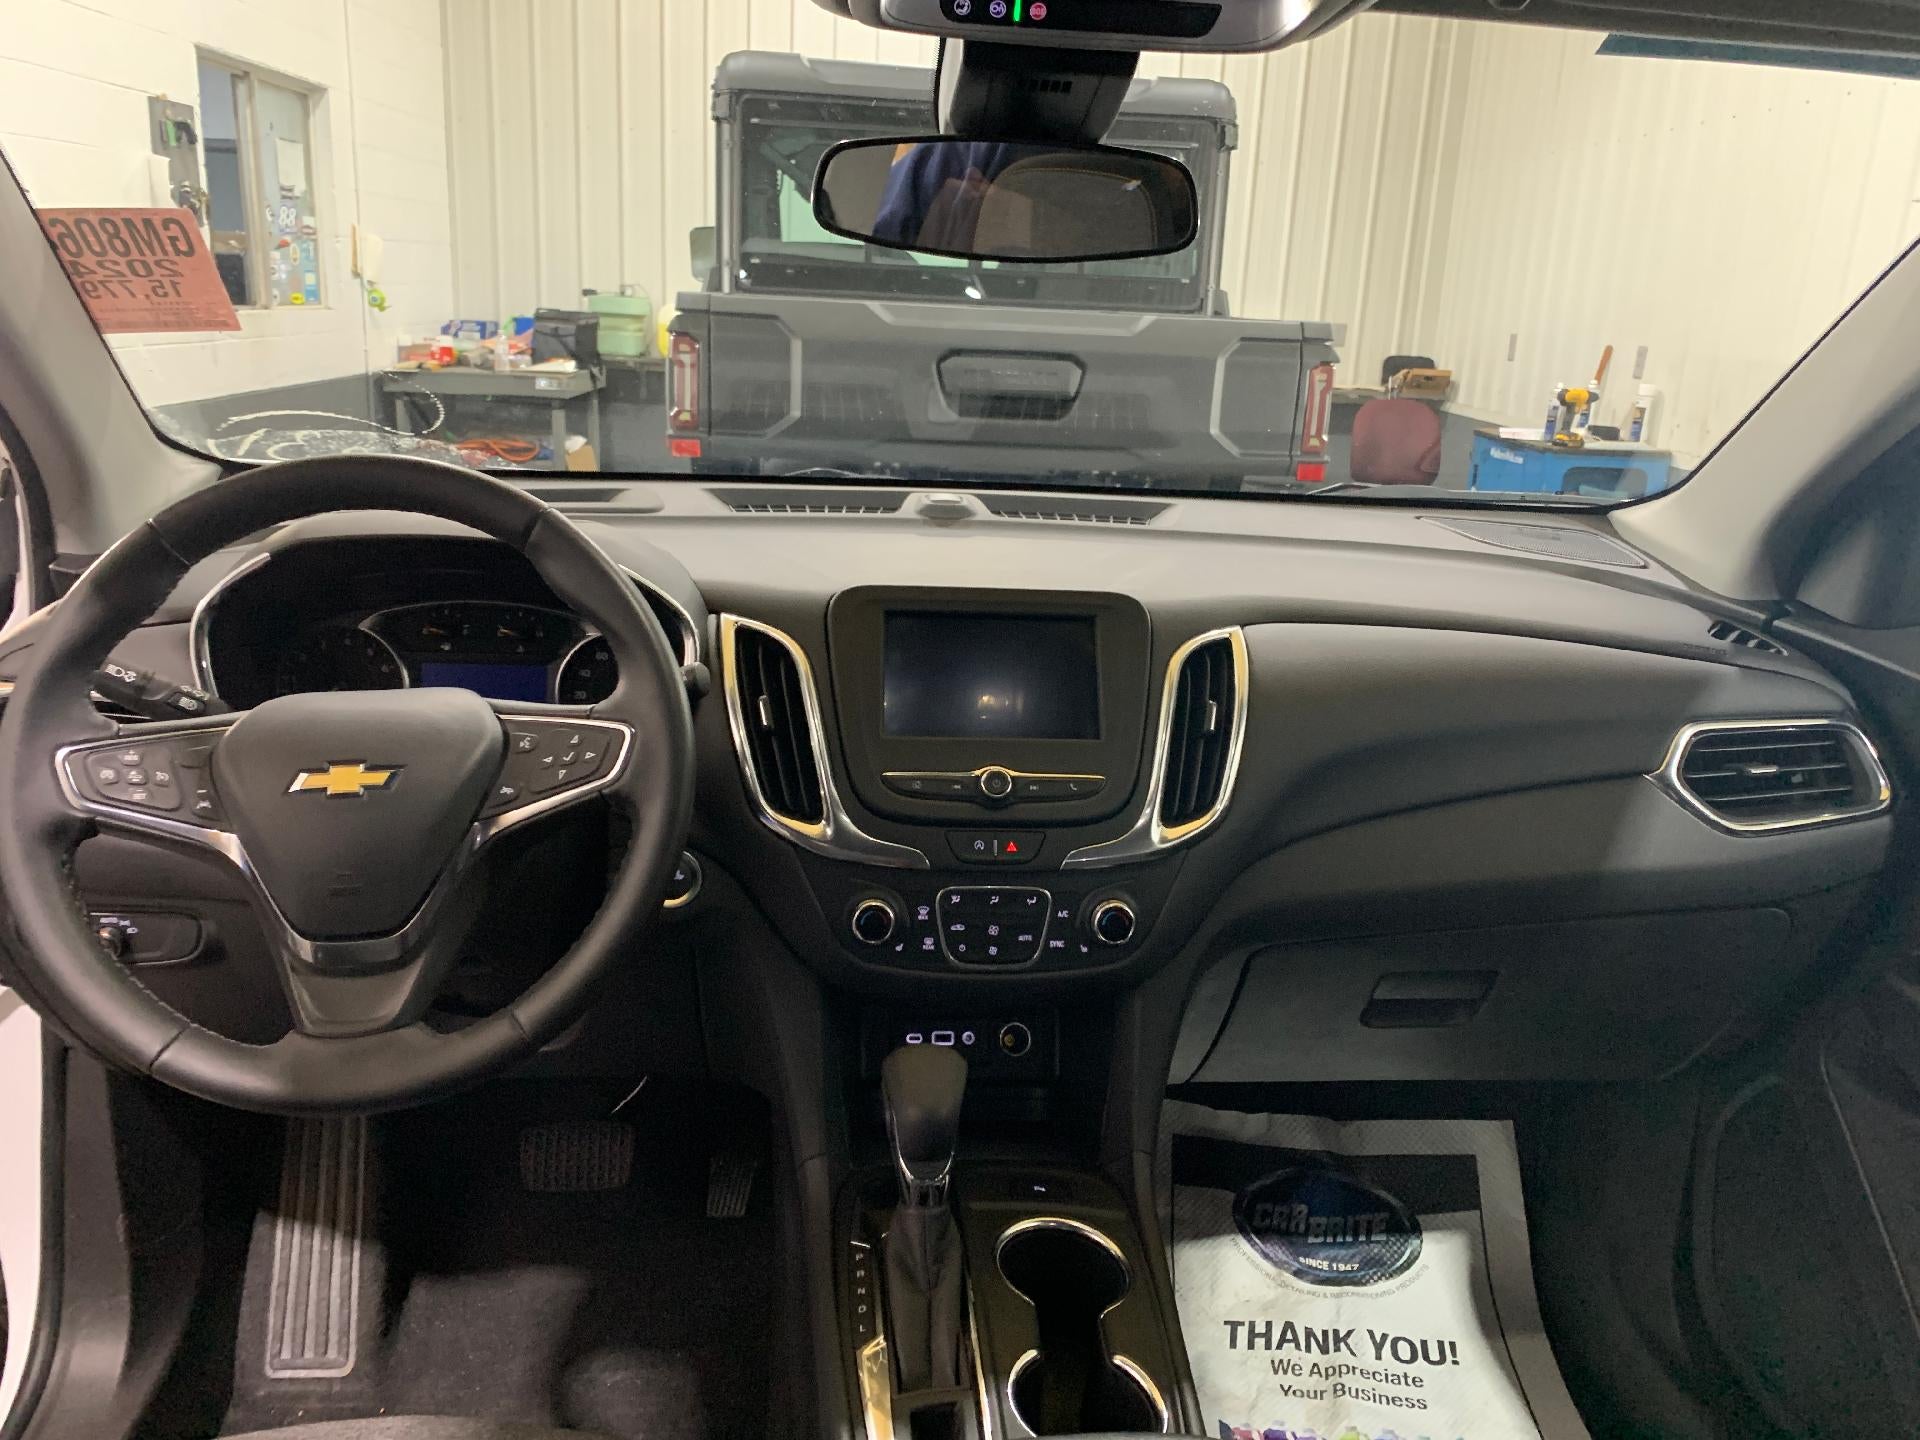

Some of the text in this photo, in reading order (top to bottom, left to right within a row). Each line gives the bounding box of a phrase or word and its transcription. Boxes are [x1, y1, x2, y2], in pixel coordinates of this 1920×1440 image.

[1057, 909, 1069, 918] A/C
[1018, 934, 1032, 942] AUTO
[1050, 939, 1065, 948] SYNC
[1307, 1211, 1389, 1244] BRITE
[1299, 1256, 1360, 1272] SINCE 1947
[857, 1287, 866, 1295] N
[1223, 1320, 1460, 1367] THANK YOU!
[1271, 1358, 1425, 1389] We Appreciate
[1279, 1382, 1428, 1411] Your Business
